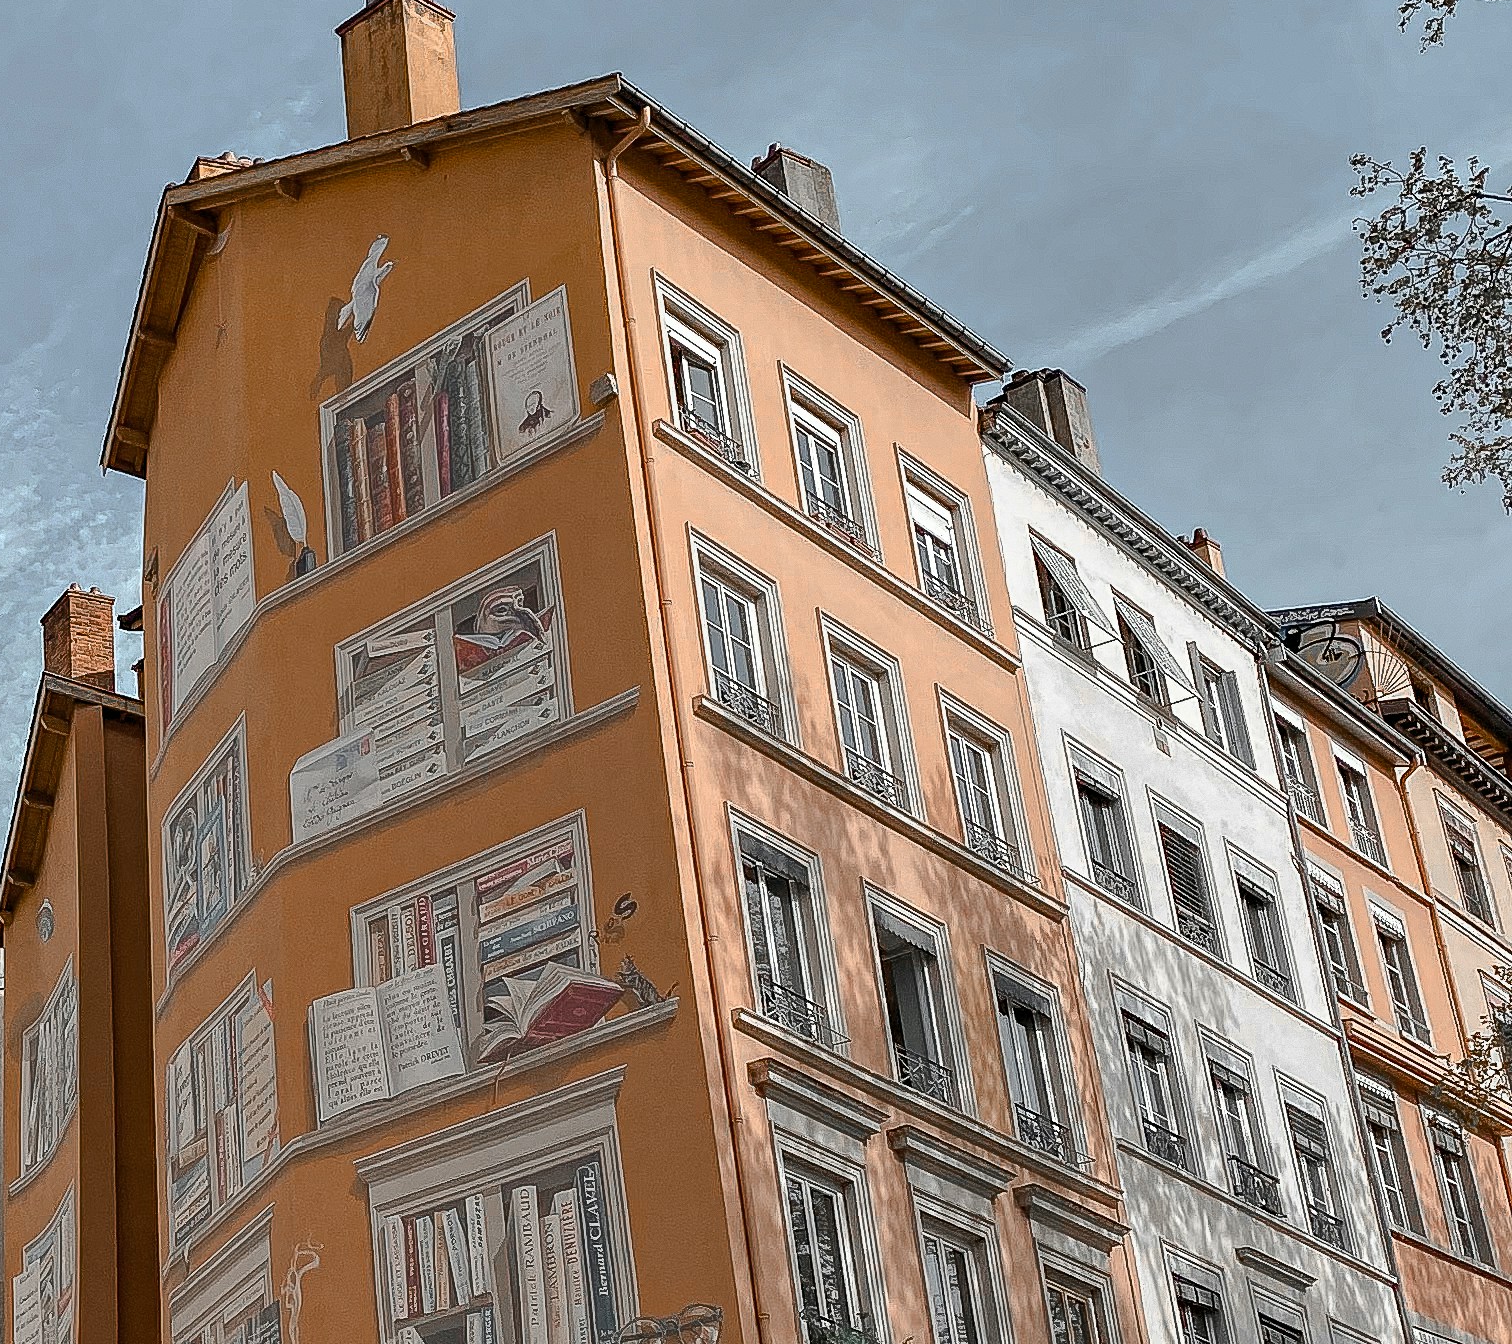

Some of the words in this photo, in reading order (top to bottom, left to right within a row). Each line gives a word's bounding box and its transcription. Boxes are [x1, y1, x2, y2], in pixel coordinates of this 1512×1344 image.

[222, 533, 248, 567] mesure
[214, 573, 229, 597] des
[418, 897, 428, 946] GIRAUD
[583, 1163, 601, 1241] CLAVEL
[520, 1188, 535, 1272] RAMBAUD
[561, 1199, 578, 1265] DENUZIÈRE
[544, 1222, 560, 1300] LAMBRON
[596, 1243, 610, 1297] Bernard
[526, 1274, 539, 1327] Patrick
[573, 1270, 583, 1306] Maurice
